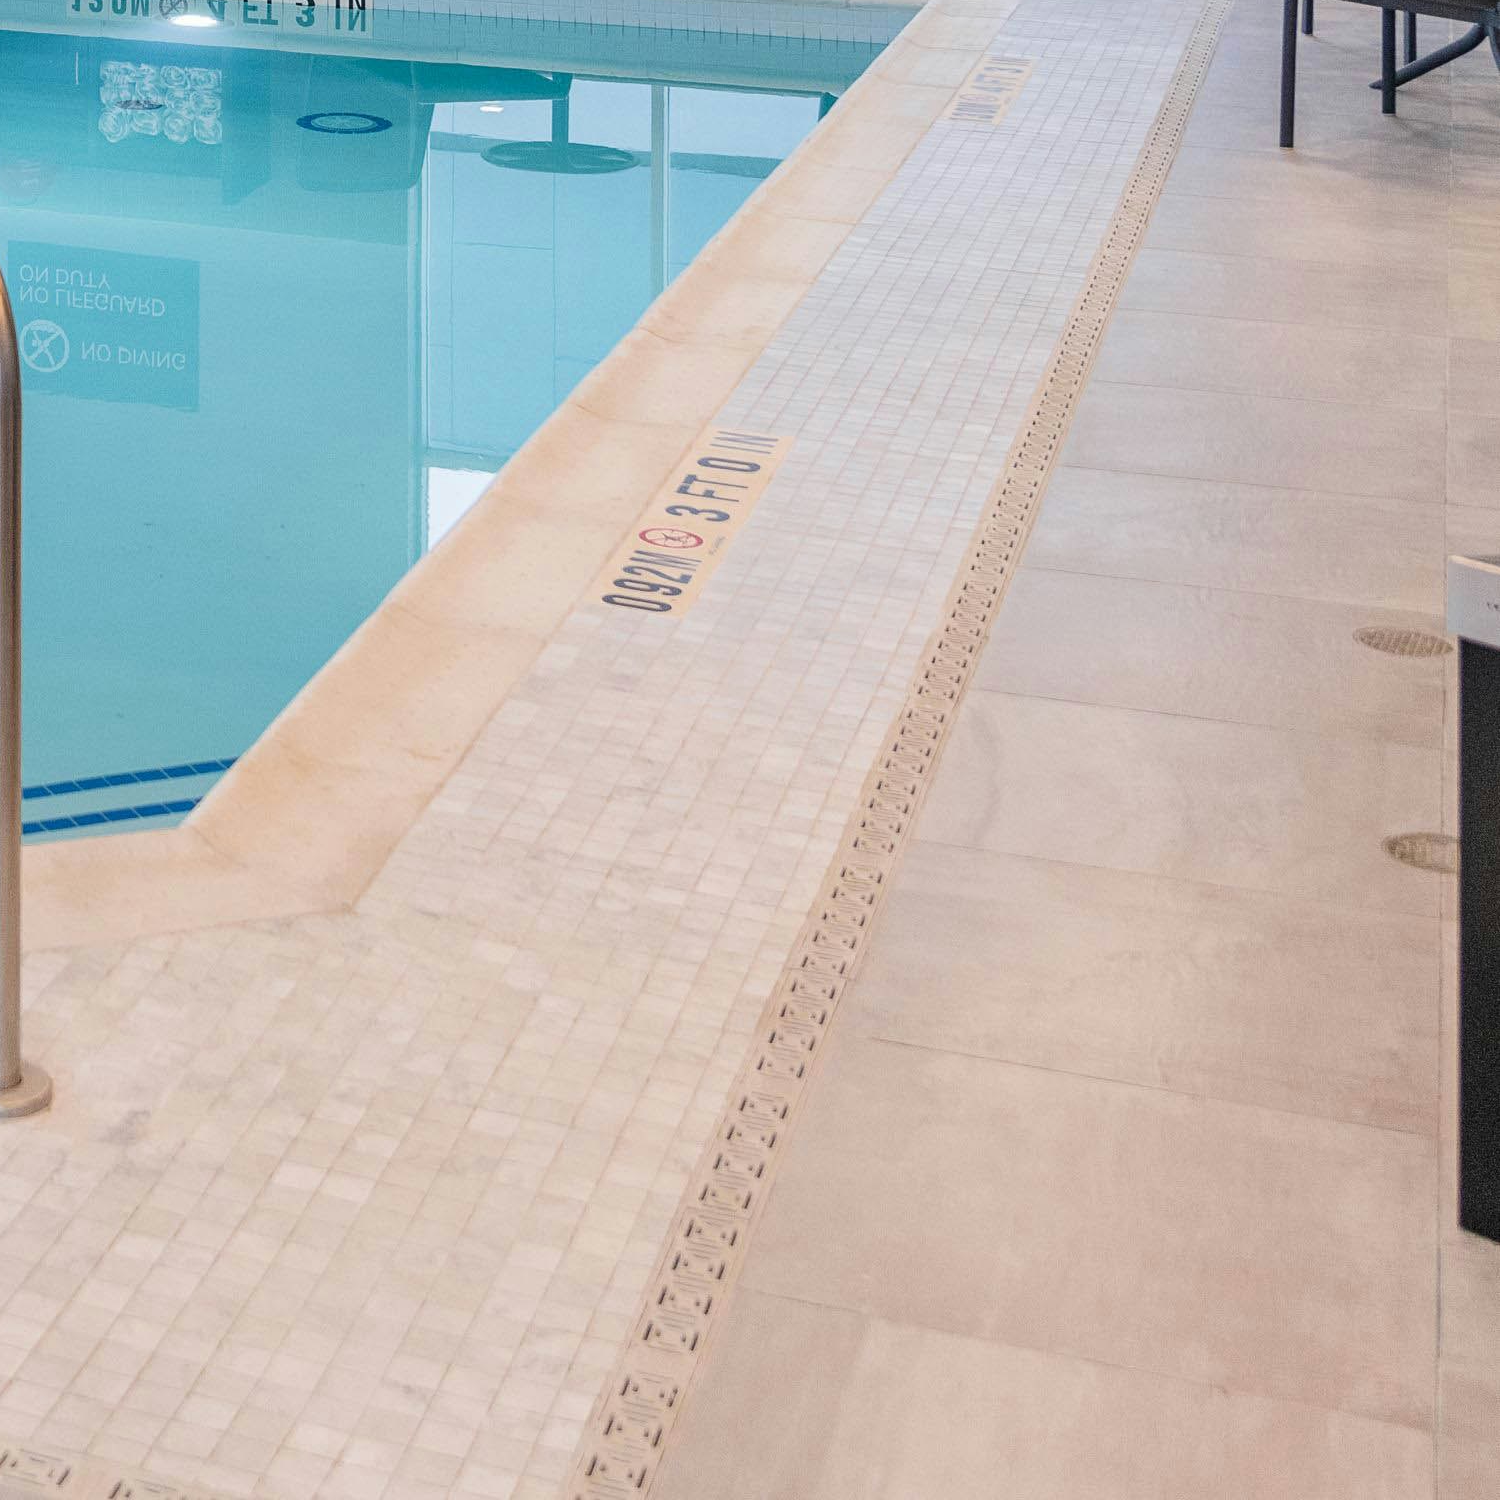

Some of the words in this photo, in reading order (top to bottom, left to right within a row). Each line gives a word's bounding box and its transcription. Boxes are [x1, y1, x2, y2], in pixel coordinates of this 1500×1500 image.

[709, 430, 779, 454] IN
[697, 457, 761, 473] 0
[676, 474, 749, 503] FT
[665, 505, 730, 522] 3
